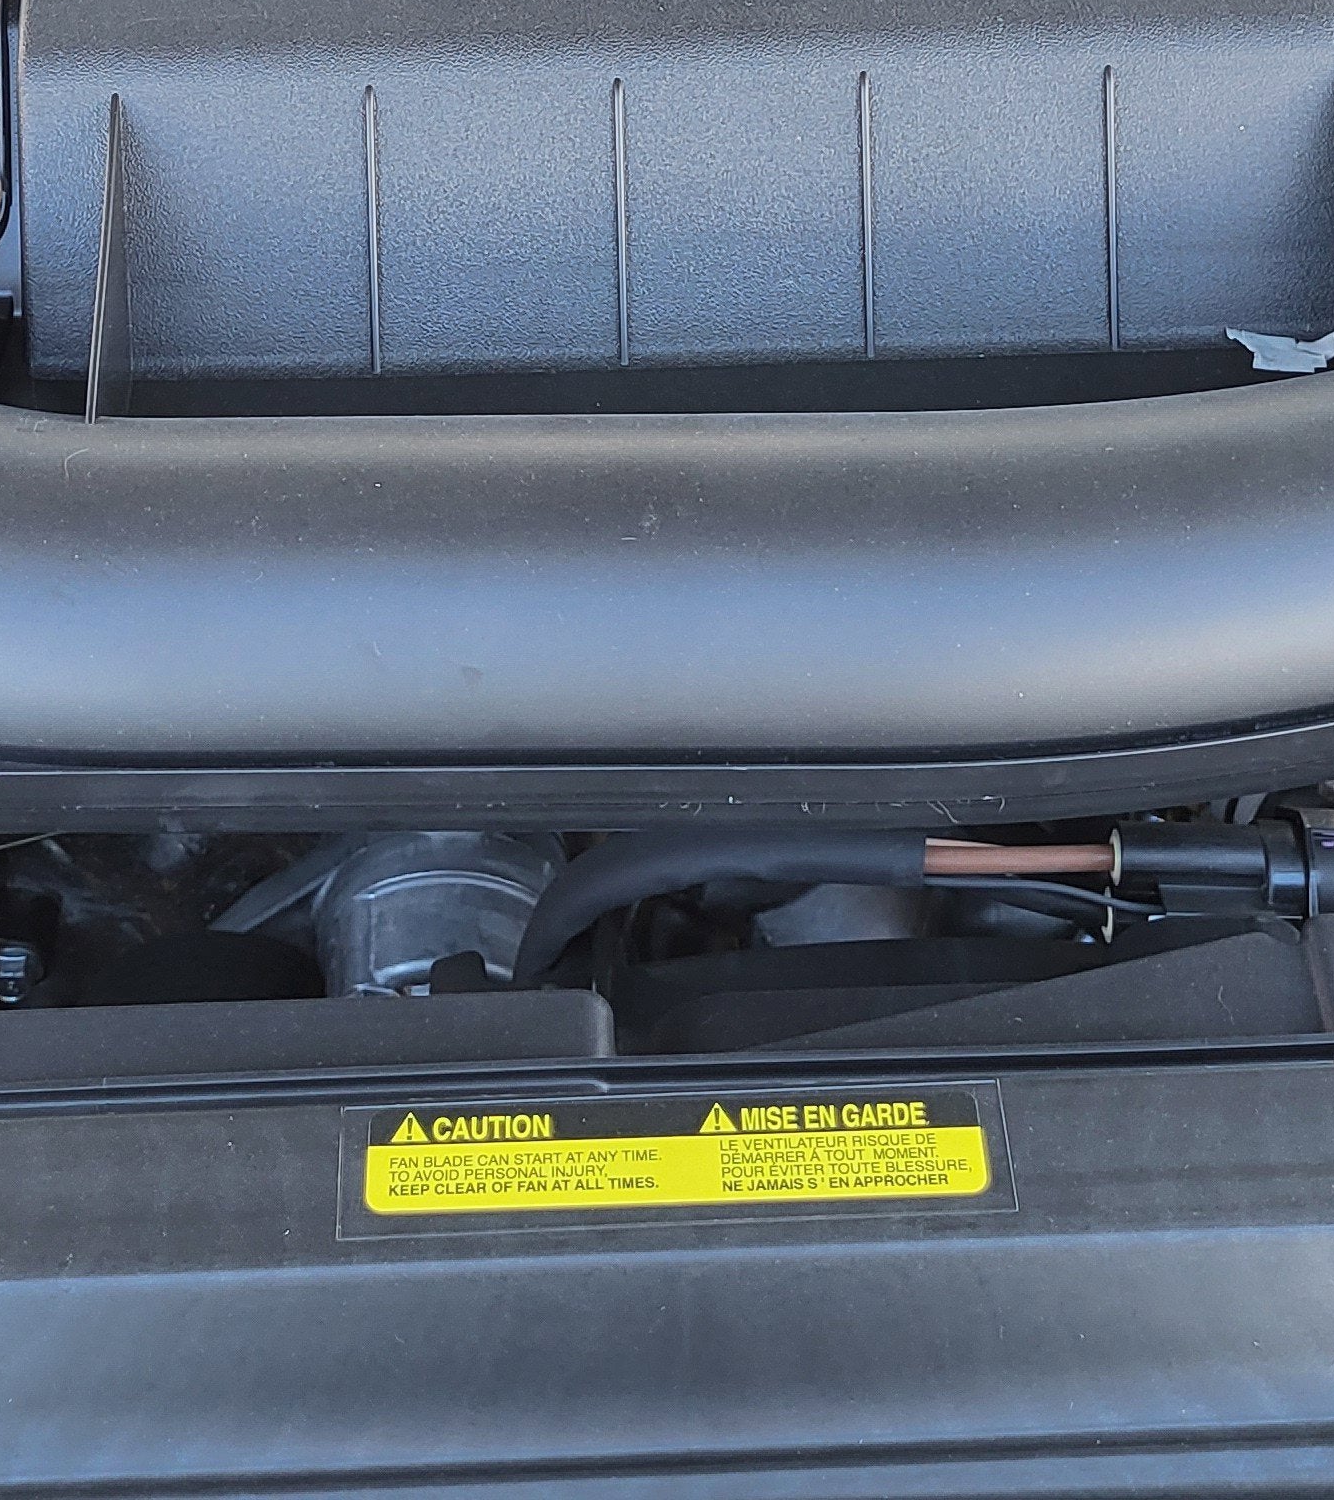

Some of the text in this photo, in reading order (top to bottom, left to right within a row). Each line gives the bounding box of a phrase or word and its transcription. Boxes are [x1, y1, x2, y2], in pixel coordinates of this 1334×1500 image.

[740, 1101, 927, 1131] MISE EN GARDE
[432, 1113, 551, 1141] CAUTION
[720, 1133, 936, 1151] LE VENTILATEUR RISQUE DE
[390, 1149, 662, 1169] FAN BLADE CAN START AT ANY TIME.
[824, 1149, 864, 1161] TOUT
[873, 1146, 939, 1160] MOMENT.
[390, 1164, 608, 1183] TO AVOID PERSONAL INJURY,
[721, 1159, 972, 1178] POUR ÉVITER TOUTE BLESSURE,
[389, 1176, 659, 1197] KEEP CLEAR OF FAN AT ALL TIMES.
[722, 1180, 743, 1192] NE
[747, 1177, 804, 1191] JAMAIS
[854, 1173, 949, 1187] APPROCHER
